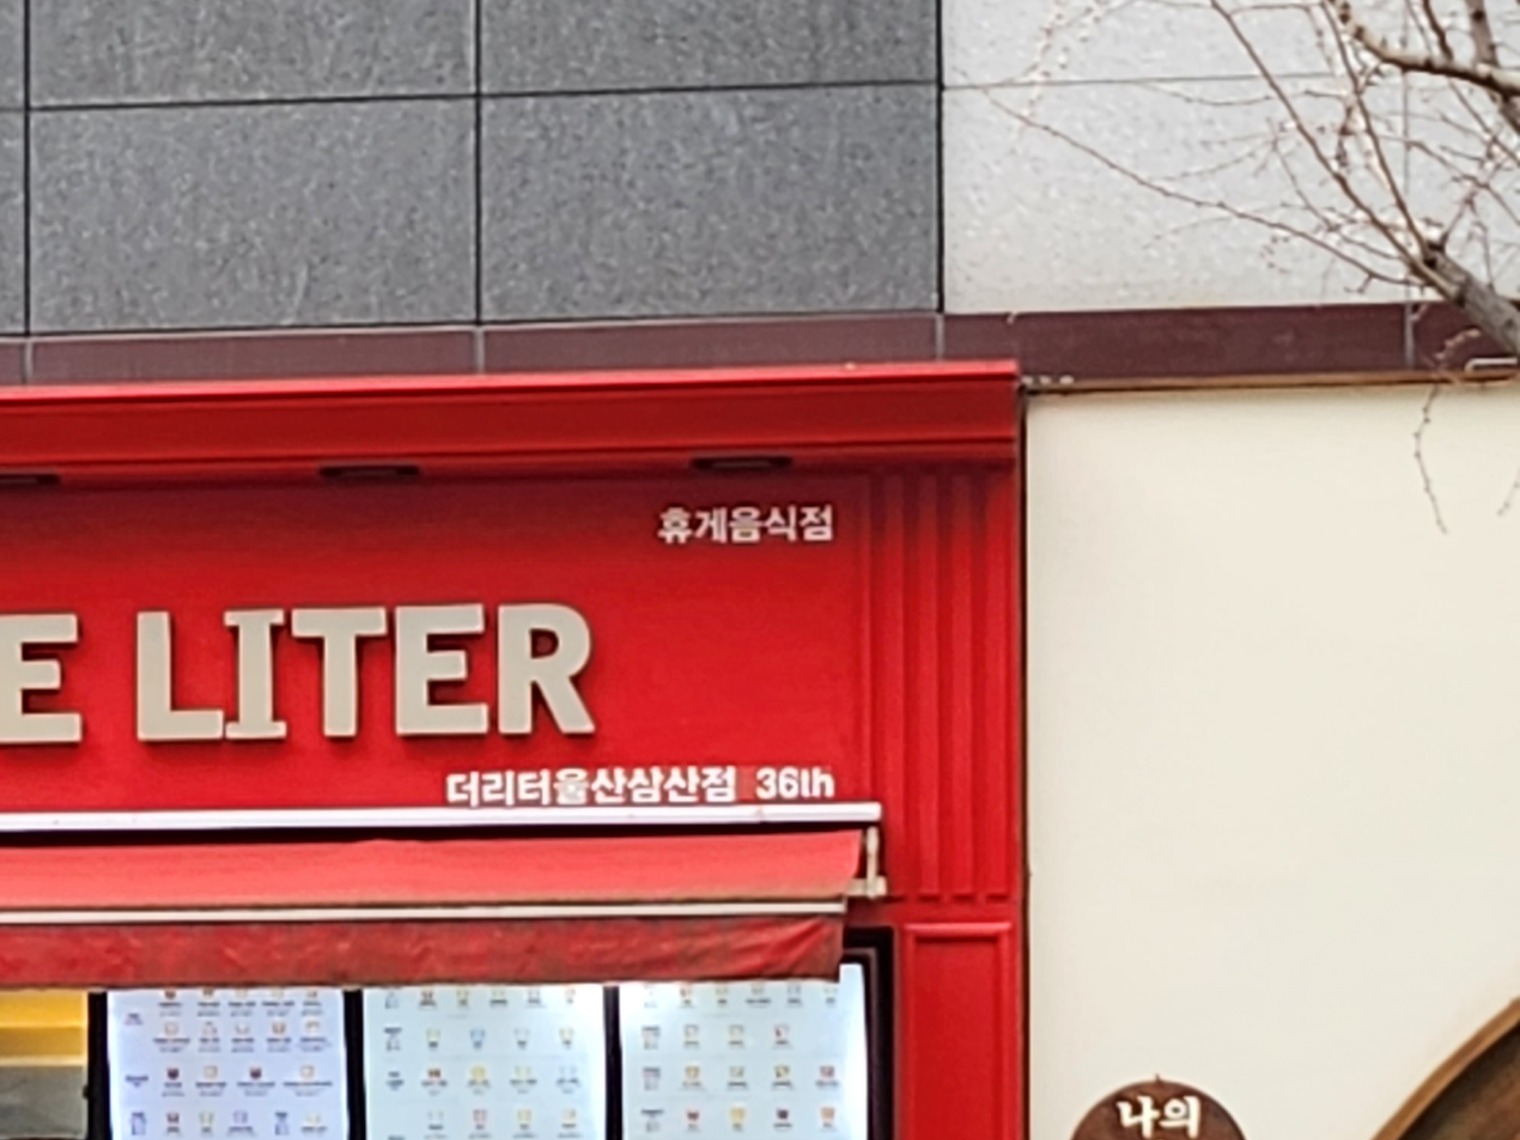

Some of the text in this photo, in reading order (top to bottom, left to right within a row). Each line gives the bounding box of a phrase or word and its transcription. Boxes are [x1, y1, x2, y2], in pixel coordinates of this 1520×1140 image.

[658, 505, 833, 543] 휴게음식점
[136, 603, 596, 742] LITER
[446, 766, 737, 807] 더리터울산삼산점
[1116, 1095, 1201, 1139] 나의
